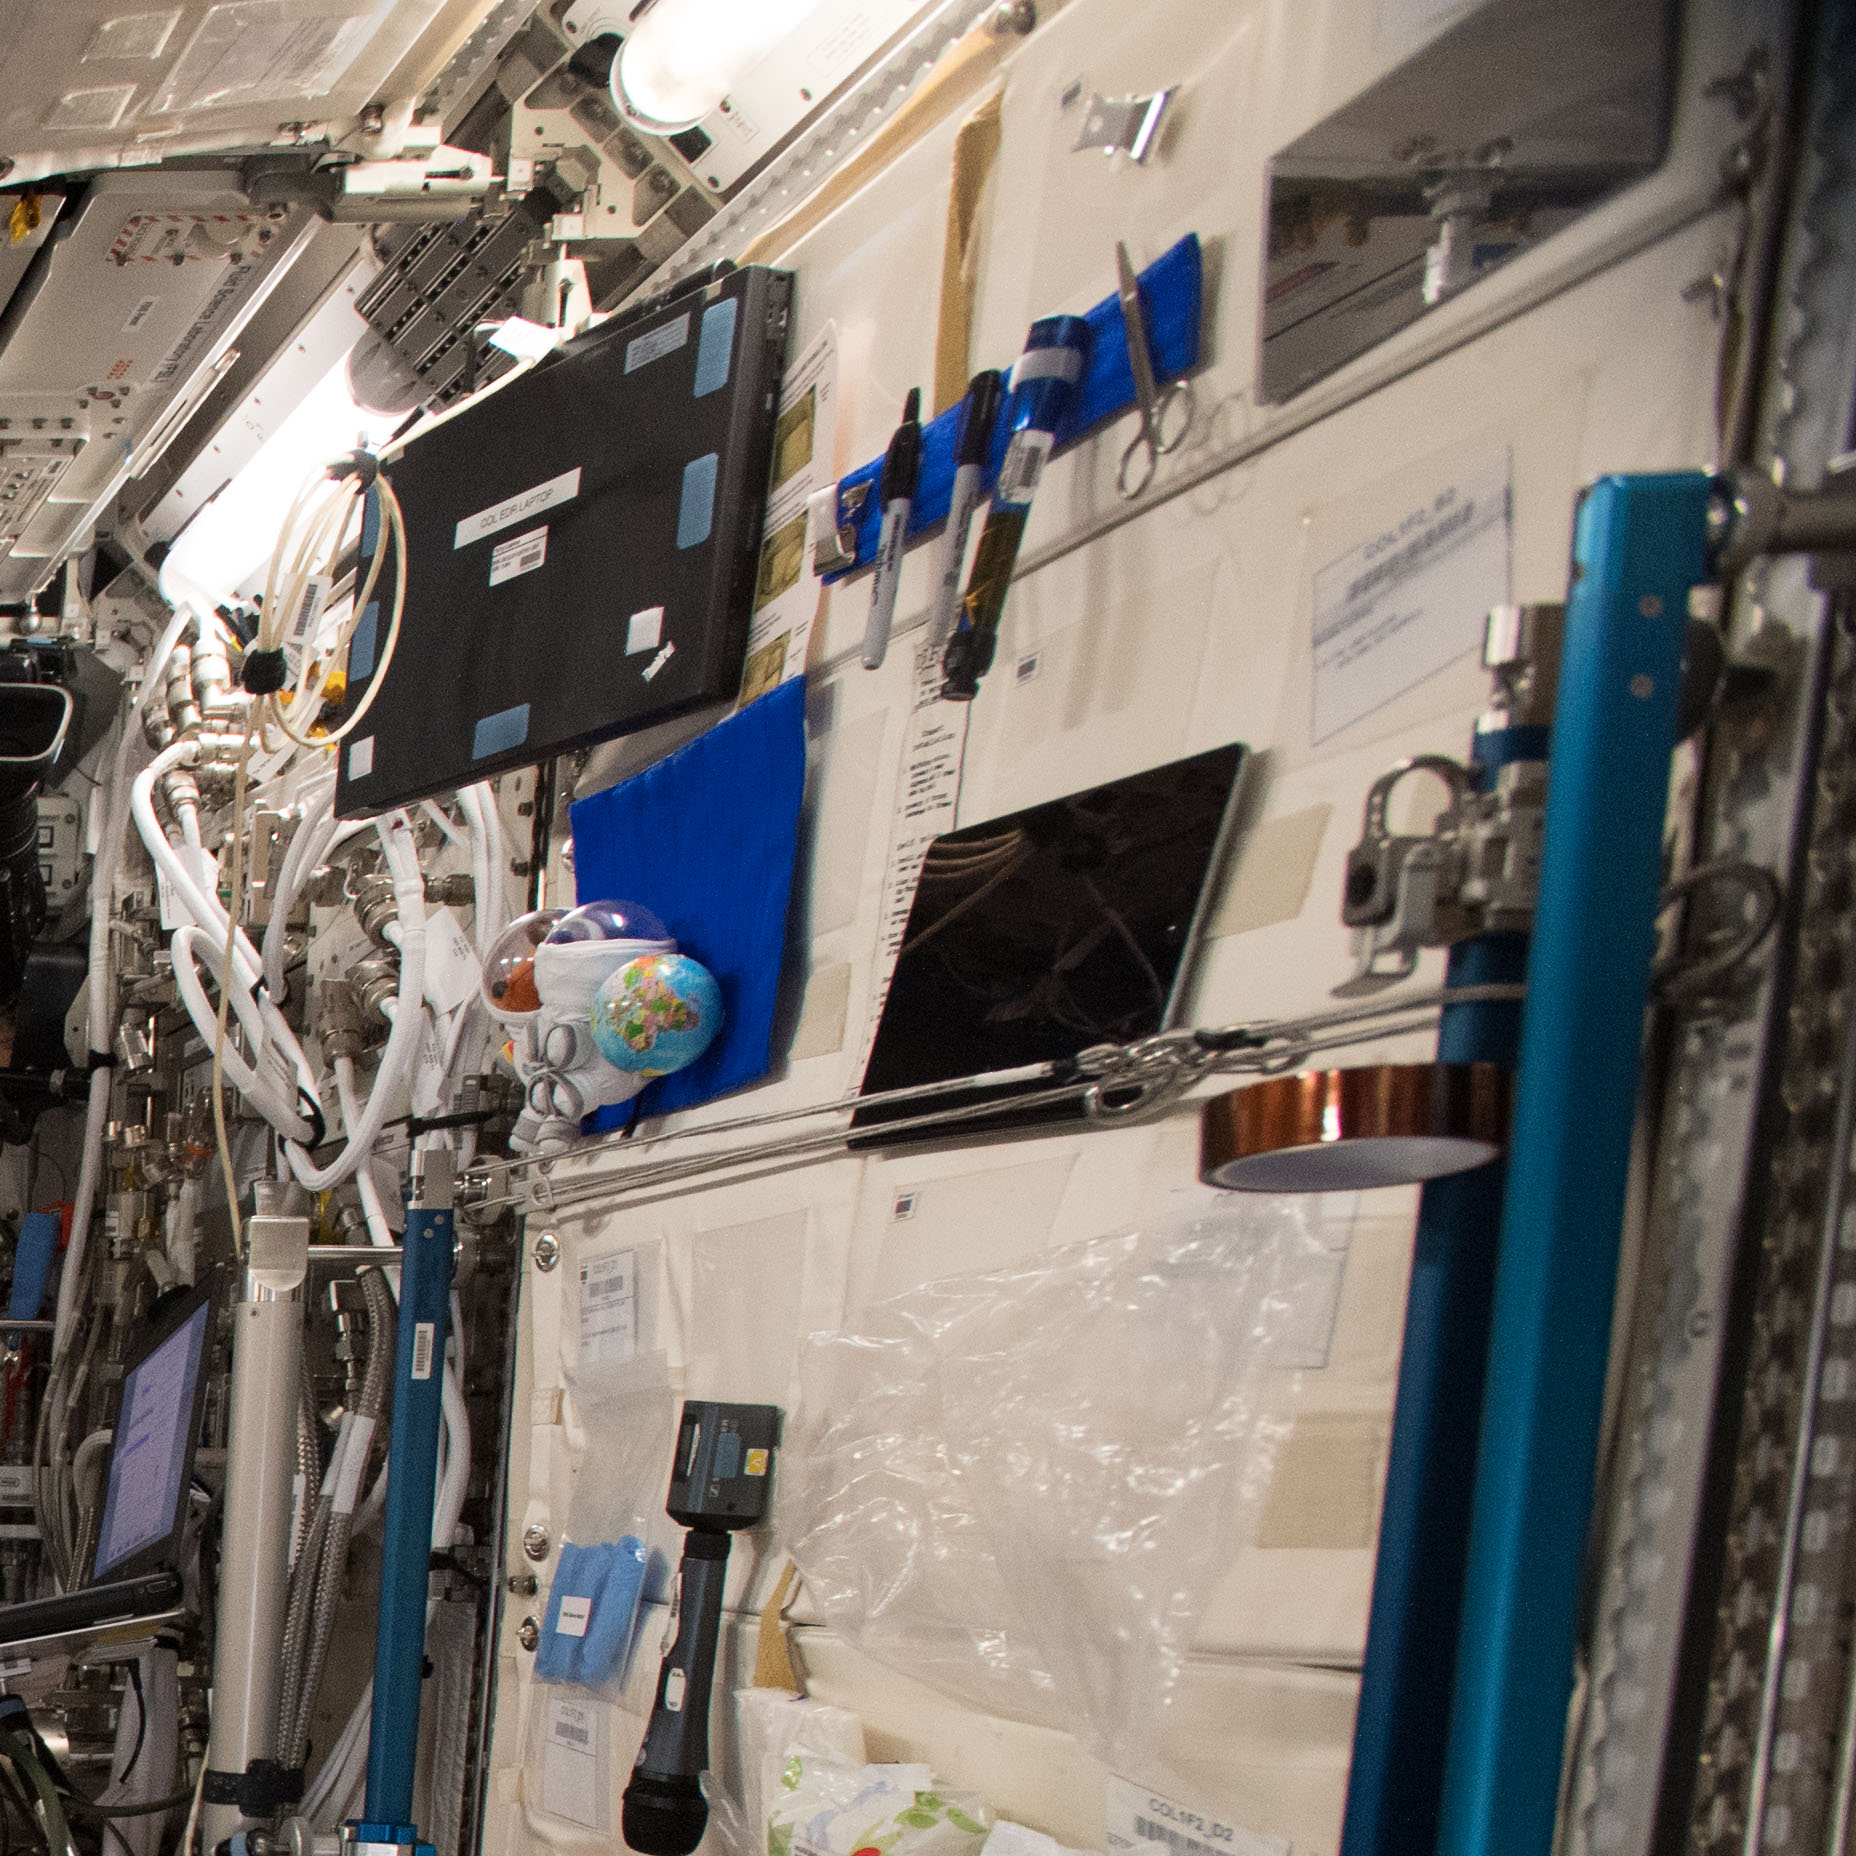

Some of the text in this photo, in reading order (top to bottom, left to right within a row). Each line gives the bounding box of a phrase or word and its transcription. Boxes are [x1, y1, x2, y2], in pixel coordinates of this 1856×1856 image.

[198, 288, 234, 319] Science
[166, 321, 210, 361] Laboratory
[480, 514, 497, 529] COL
[519, 488, 553, 511] LAPTOP
[1149, 1799, 1233, 1841] COL1F2_D2
